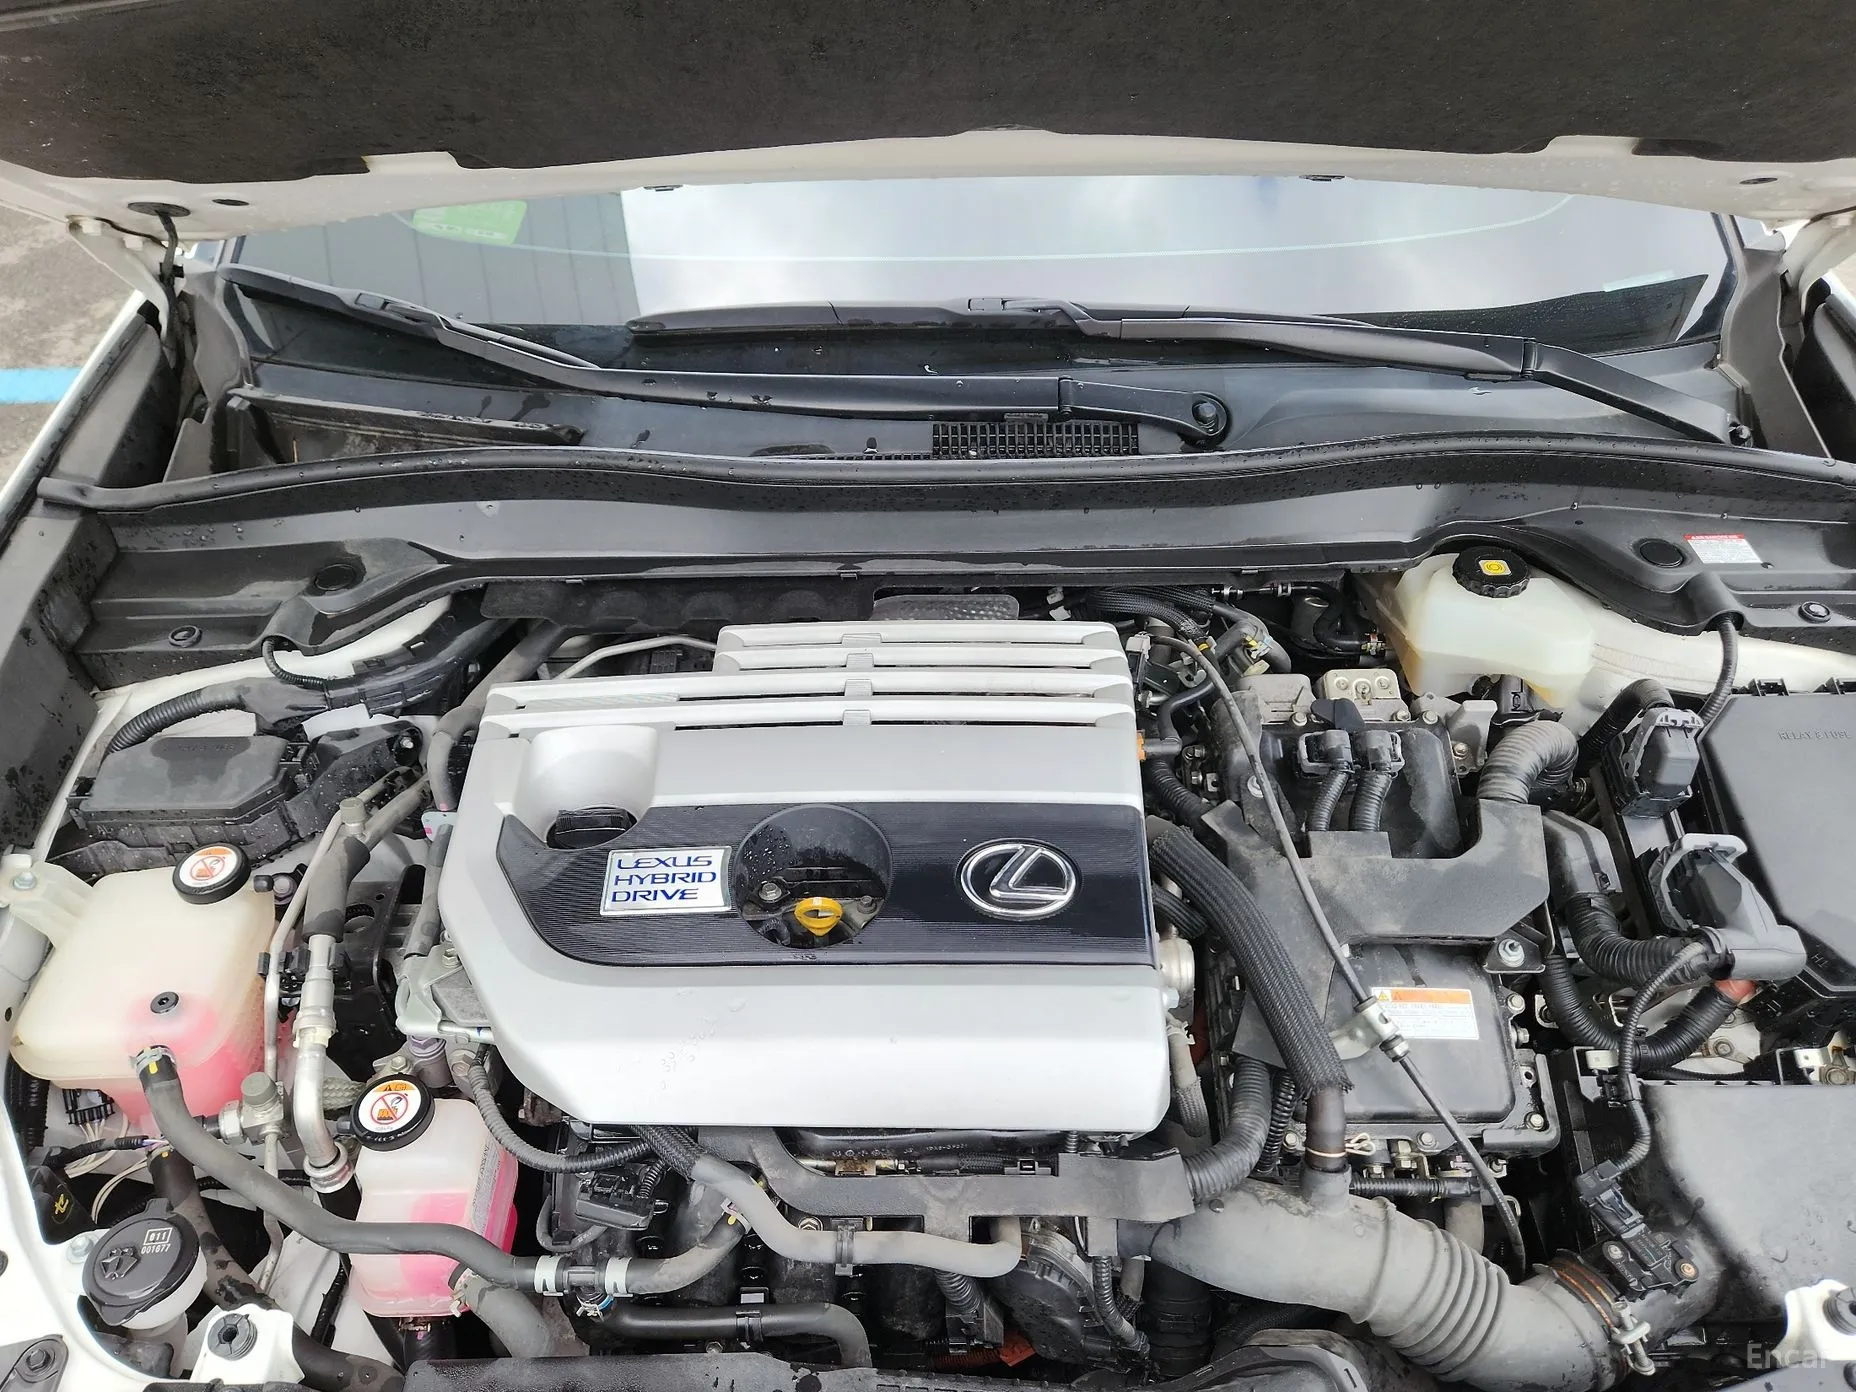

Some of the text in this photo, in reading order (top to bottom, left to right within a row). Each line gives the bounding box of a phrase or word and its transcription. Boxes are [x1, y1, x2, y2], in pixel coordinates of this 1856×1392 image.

[616, 855, 713, 870] LEXUS
[613, 871, 717, 886] HYBRID
[611, 888, 699, 902] DRIVE
